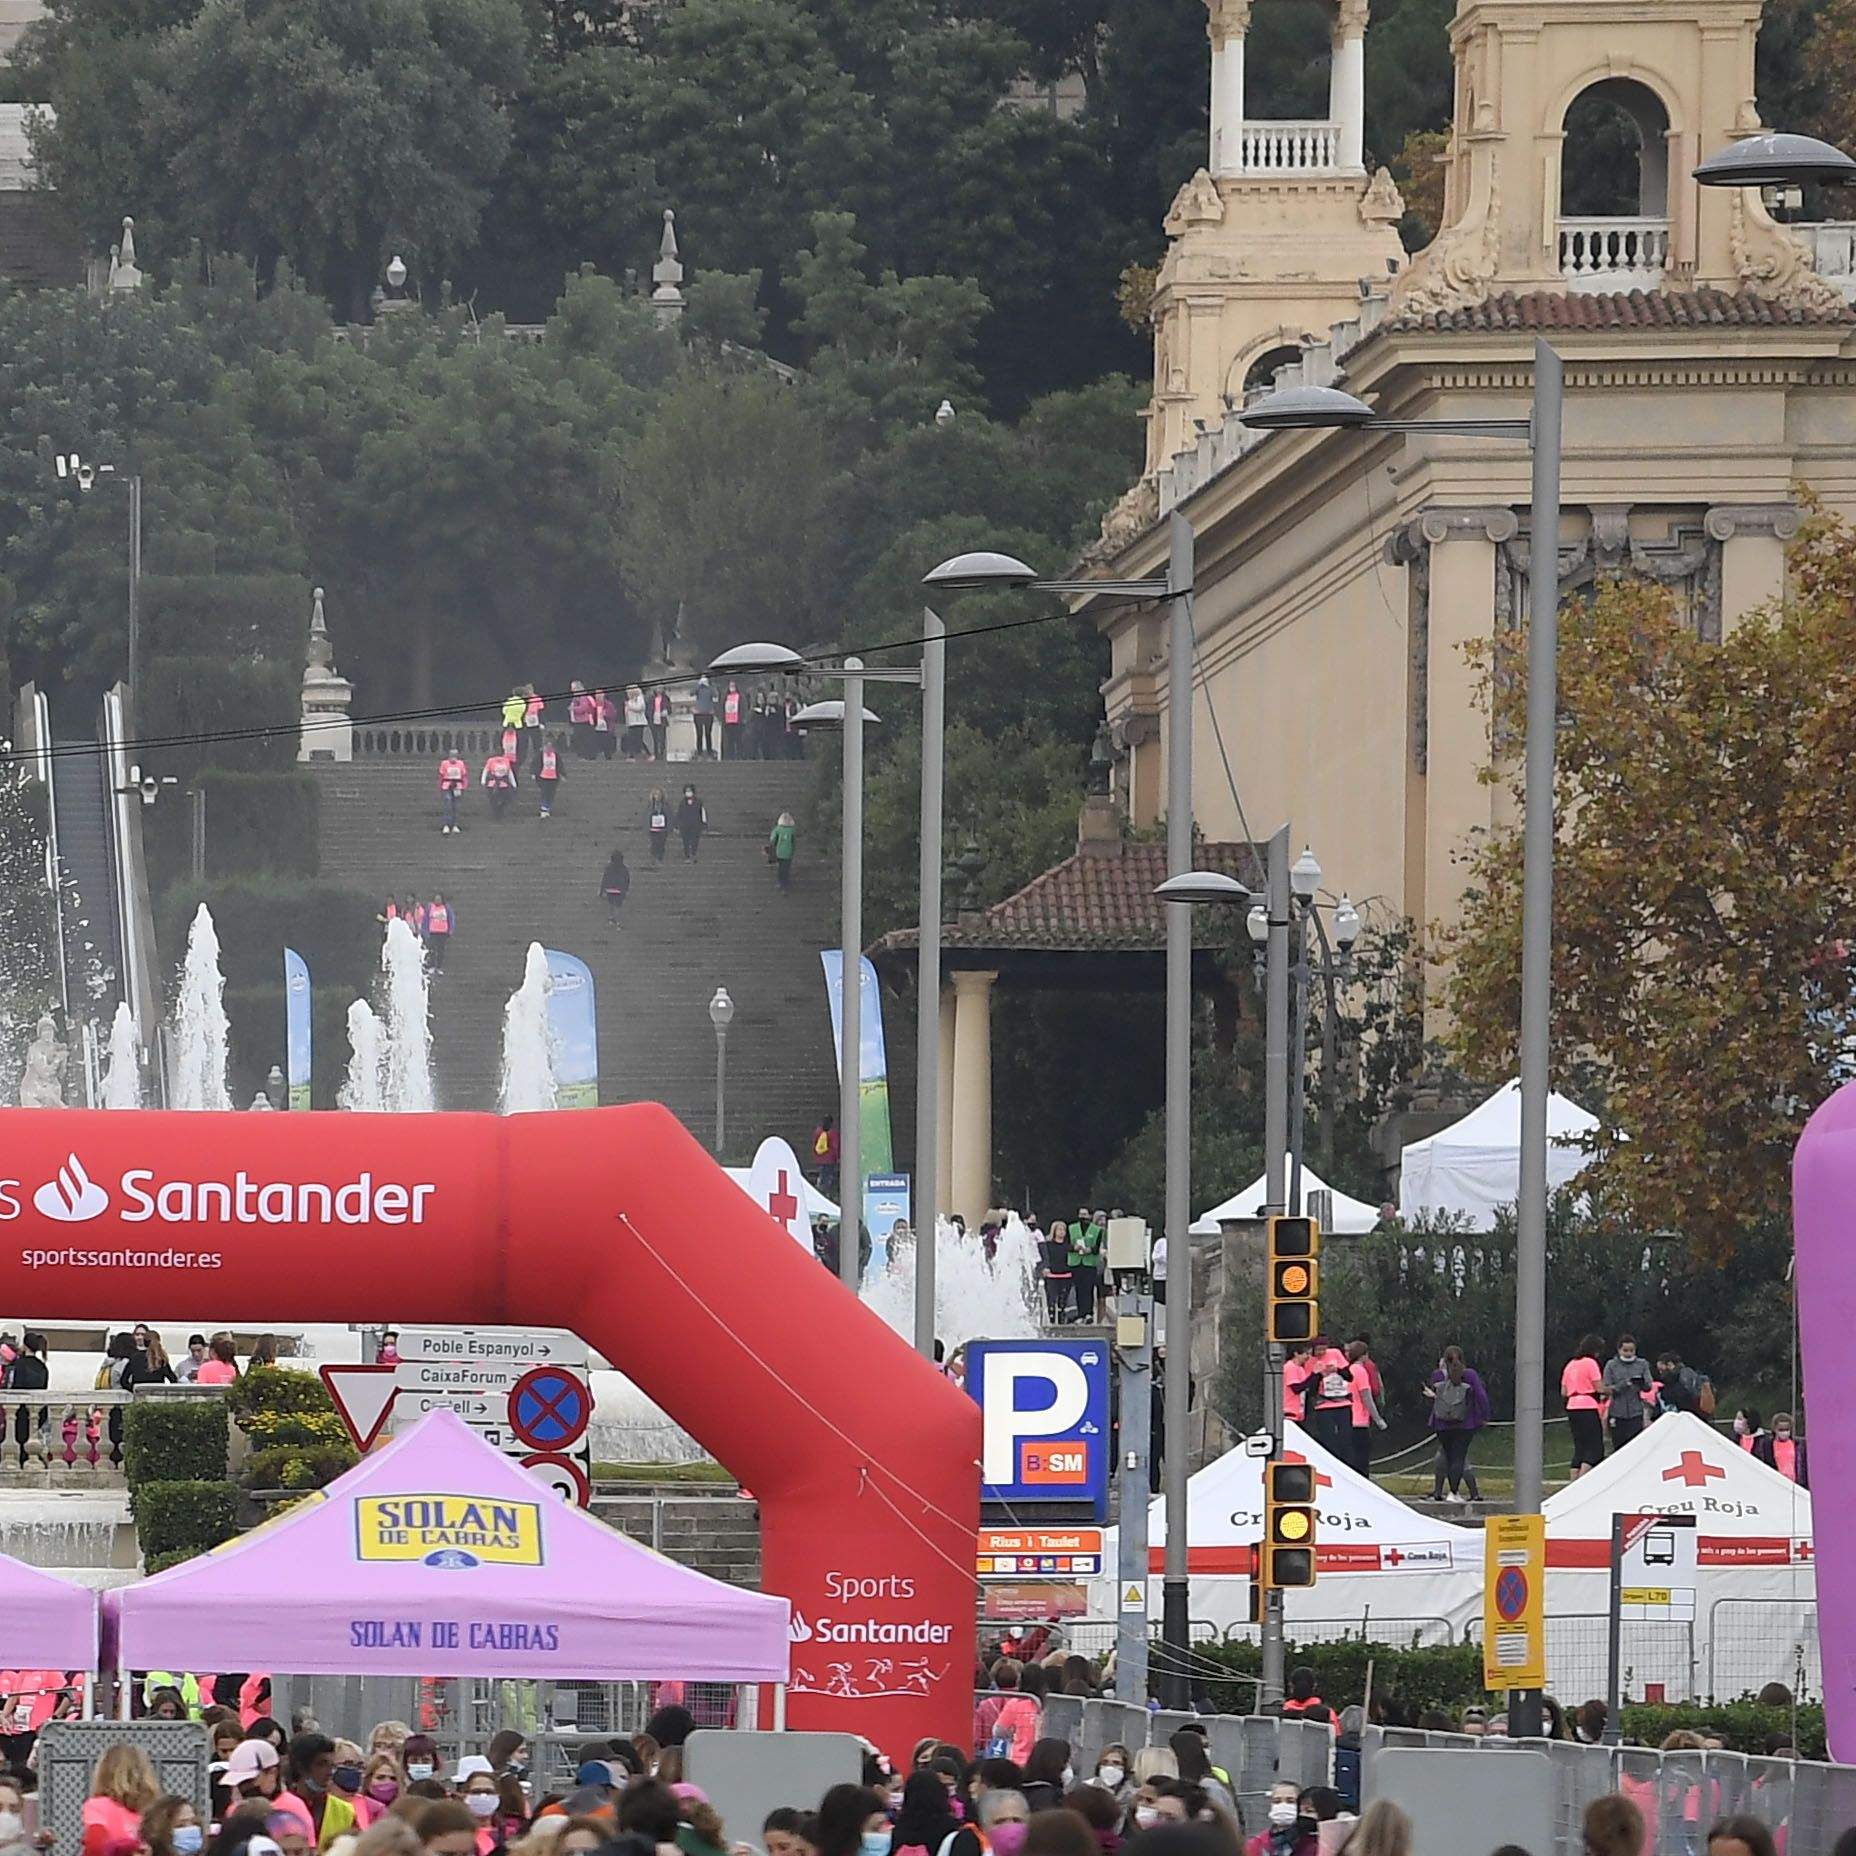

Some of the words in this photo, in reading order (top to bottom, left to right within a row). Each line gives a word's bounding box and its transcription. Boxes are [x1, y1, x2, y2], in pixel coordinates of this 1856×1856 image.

[121, 1170, 434, 1223] Santander
[23, 1248, 220, 1268] sportssantander.es
[423, 1339, 463, 1354] Poble
[469, 1340, 534, 1358] Espanyol
[420, 1369, 507, 1384] CaixaForum
[420, 1399, 470, 1414] Cell
[983, 1352, 1089, 1485] P
[377, 1500, 519, 1533] SOLAN
[1703, 1497, 1759, 1517] Roja
[1231, 1511, 1263, 1527] Cr
[379, 1530, 408, 1545] DE
[422, 1530, 520, 1549] CABRAS
[989, 1535, 1021, 1548] Rius
[1027, 1535, 1033, 1548] i
[1039, 1535, 1080, 1548] Taulet
[824, 1571, 915, 1604] Sports
[350, 1621, 422, 1648] SOLAN
[432, 1622, 459, 1649] DE
[469, 1623, 559, 1651] CABRAS
[815, 1617, 953, 1644] Santander
